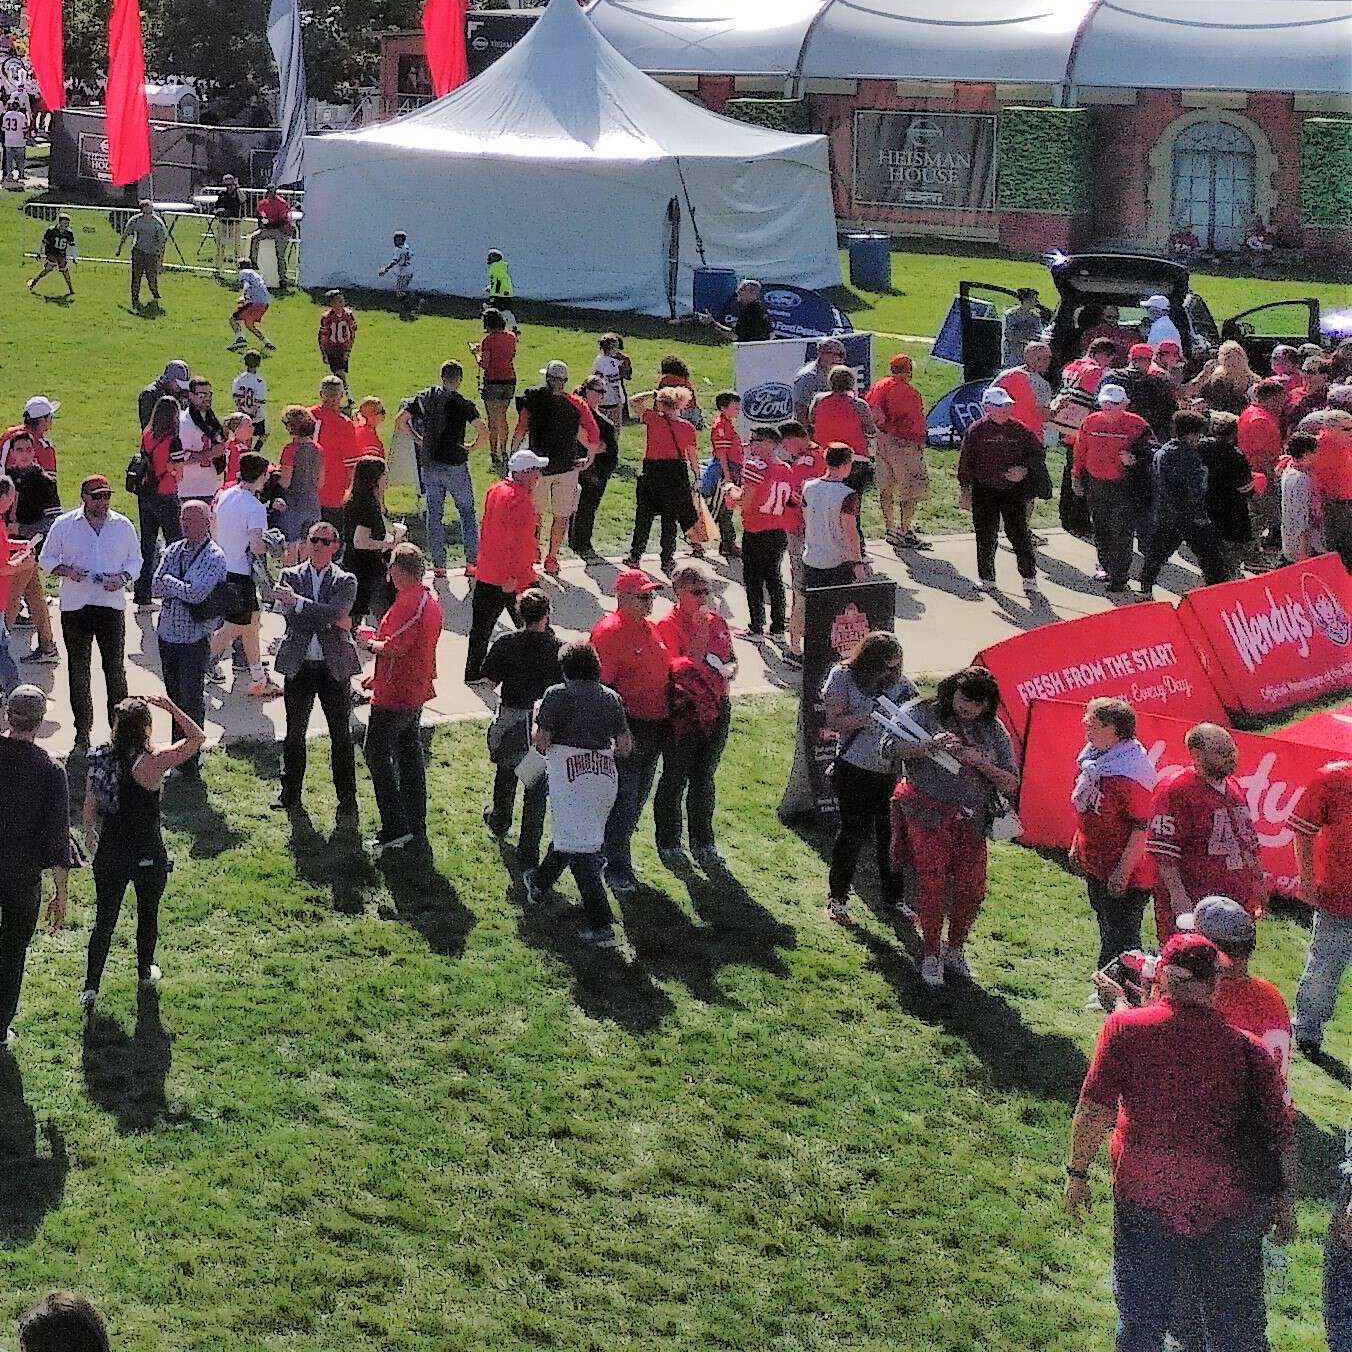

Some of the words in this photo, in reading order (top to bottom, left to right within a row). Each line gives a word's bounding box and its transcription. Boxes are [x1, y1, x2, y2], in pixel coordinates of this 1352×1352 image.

[878, 149, 972, 168] HEISMAN
[888, 167, 958, 184] HOUSE
[329, 320, 351, 343] 10
[747, 390, 791, 415] Ford
[1220, 586, 1314, 674] Wendy's
[1016, 670, 1065, 706] FRESH
[1062, 660, 1108, 691] FROM
[1102, 651, 1136, 678] THE
[1132, 642, 1178, 672] START
